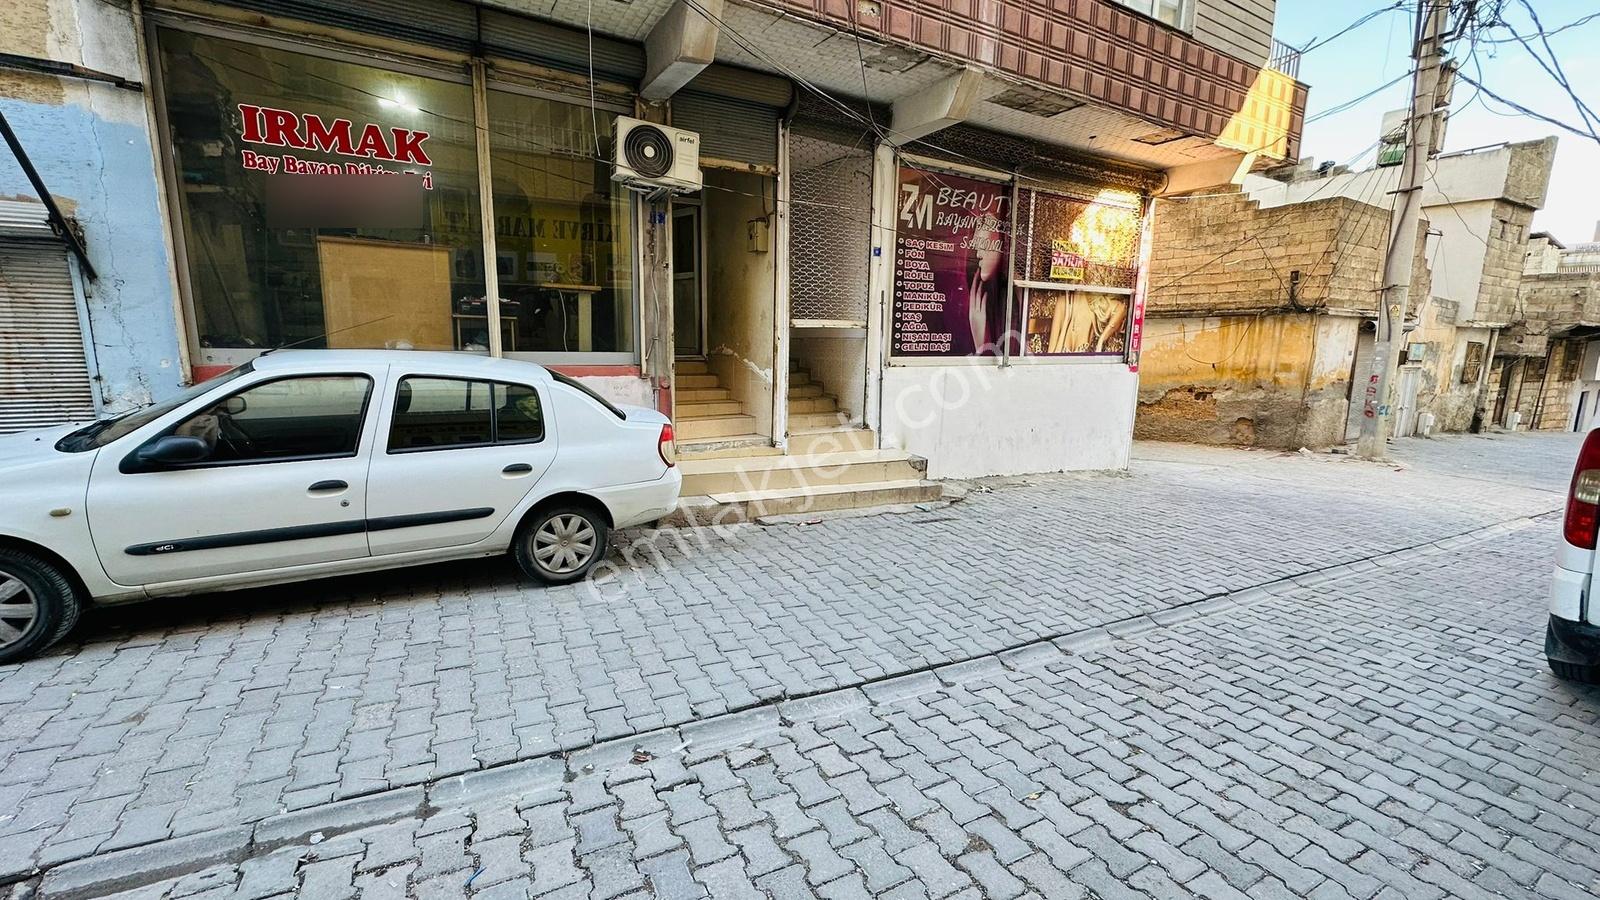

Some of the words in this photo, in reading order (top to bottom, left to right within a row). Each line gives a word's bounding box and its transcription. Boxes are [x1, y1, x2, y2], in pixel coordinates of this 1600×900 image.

[238, 104, 432, 165] IRMAK
[242, 150, 280, 174] Bay
[936, 211, 976, 234] BAYAN
[905, 239, 925, 249] SAÇ
[905, 248, 925, 259] FÖN
[904, 260, 930, 270] BOYA
[904, 270, 934, 280] RÖFLE
[903, 281, 935, 291] TOPUZ
[902, 312, 922, 322] KAŞ
[901, 322, 928, 331] AĞDA
[931, 333, 952, 342] BAŞI
[930, 343, 951, 352] BAŞI
